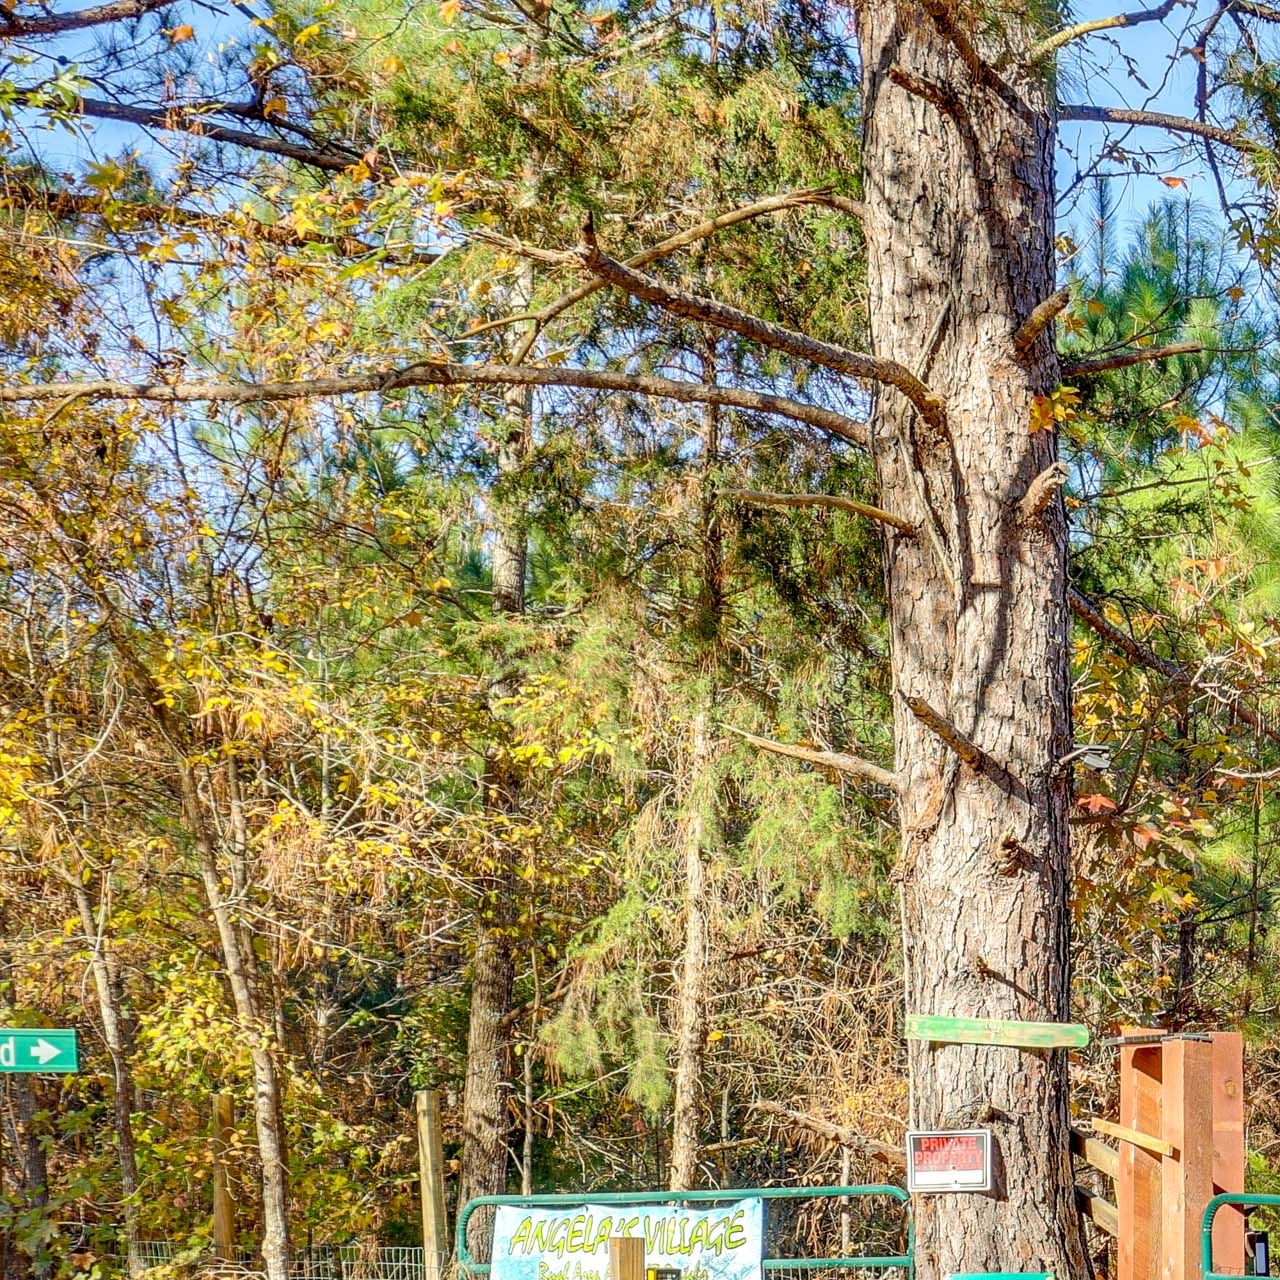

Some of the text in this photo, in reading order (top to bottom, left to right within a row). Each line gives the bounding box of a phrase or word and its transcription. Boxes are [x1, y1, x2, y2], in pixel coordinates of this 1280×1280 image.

[0, 1036, 16, 1067] d
[920, 1137, 977, 1151] PRIVATE
[914, 1150, 984, 1164] PROPERTY
[644, 1210, 746, 1257] VILLAGE
